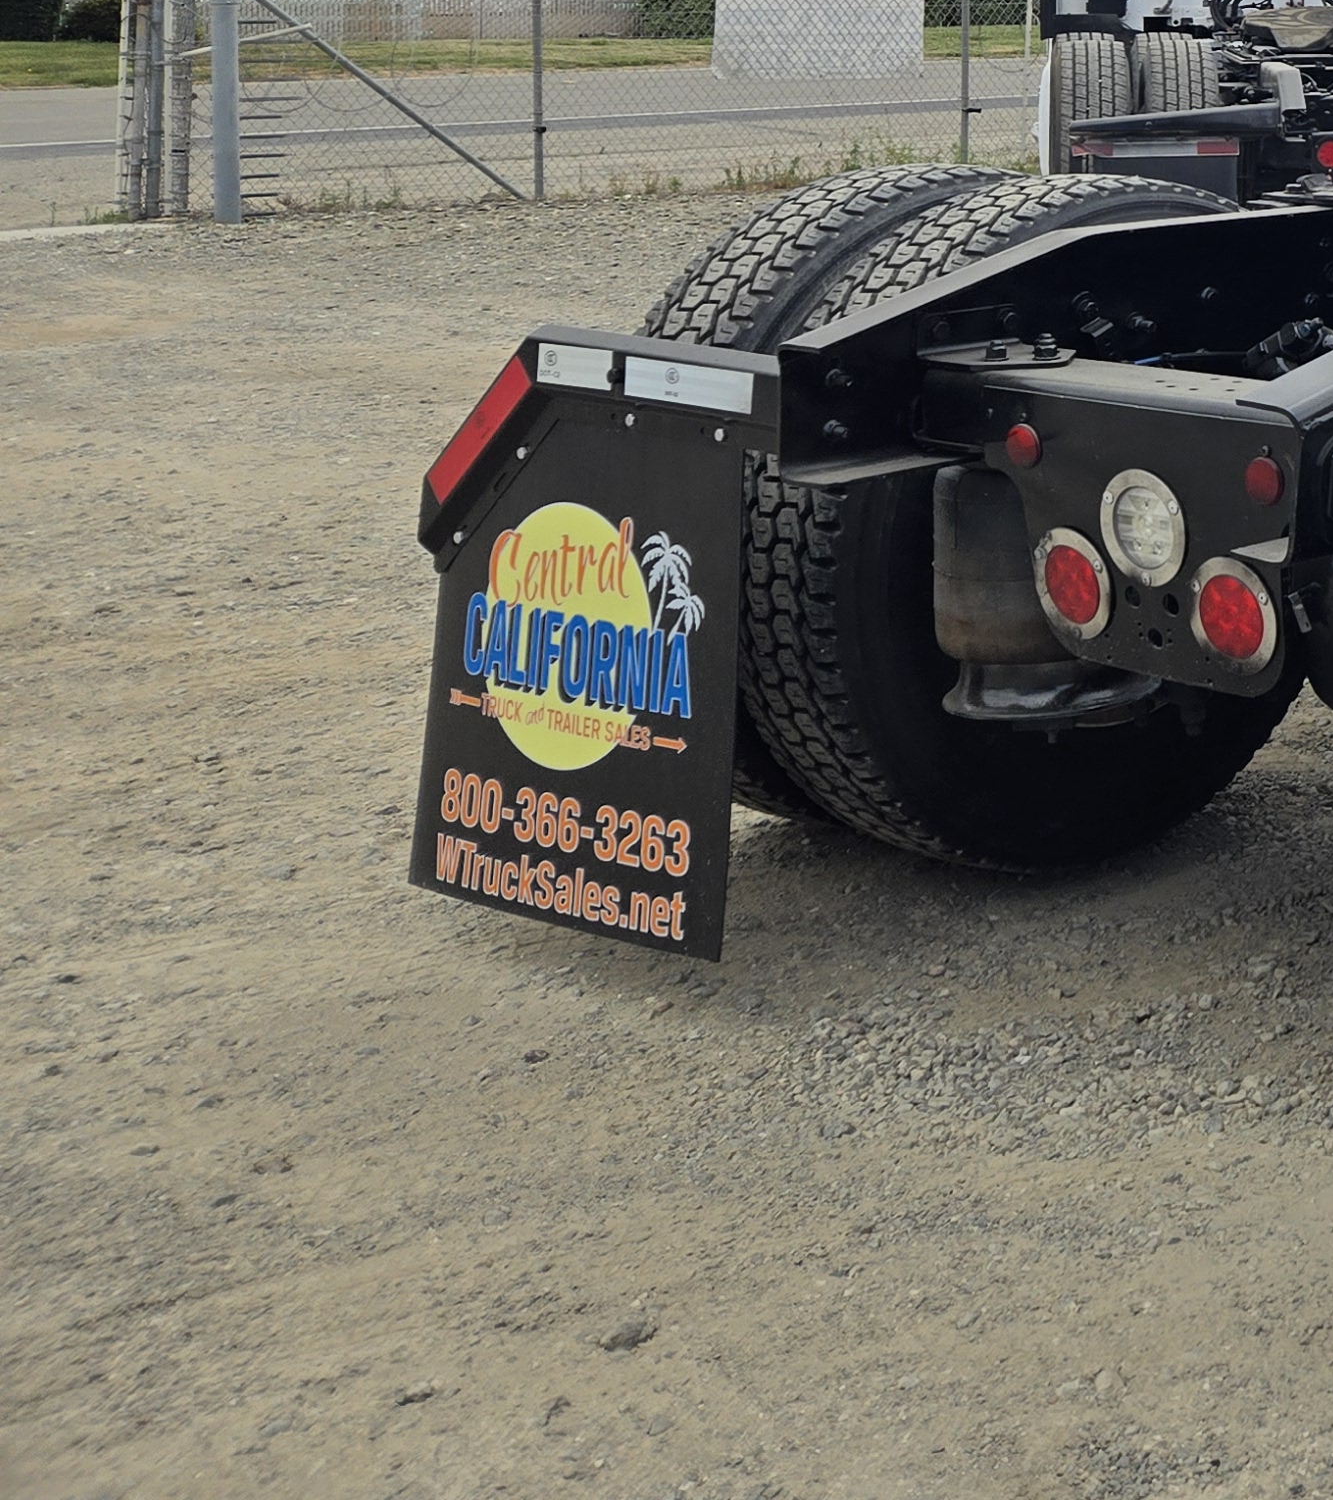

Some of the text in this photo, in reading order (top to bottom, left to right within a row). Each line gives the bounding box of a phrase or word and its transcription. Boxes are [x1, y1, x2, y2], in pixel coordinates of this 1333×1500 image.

[489, 516, 635, 607] Central
[463, 591, 692, 719] CALIFORNIA
[481, 693, 651, 751] TRUCK and TRAILER SALES
[440, 768, 692, 877] 800-366-3263
[436, 832, 686, 941] WTruckSales.net
